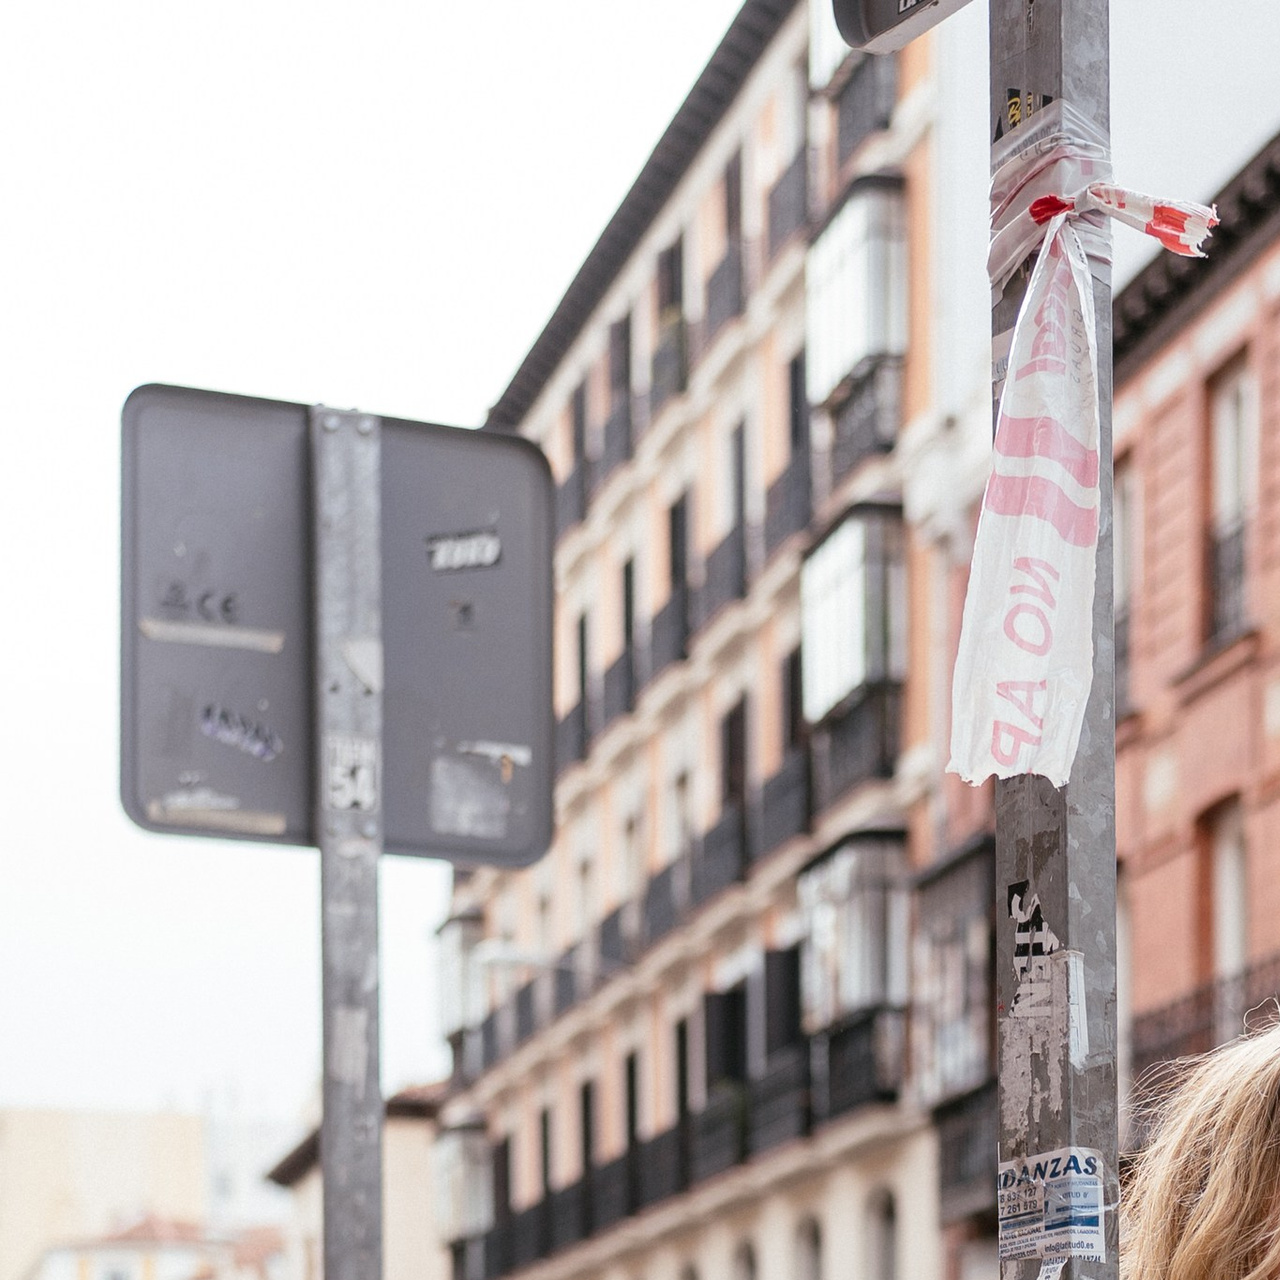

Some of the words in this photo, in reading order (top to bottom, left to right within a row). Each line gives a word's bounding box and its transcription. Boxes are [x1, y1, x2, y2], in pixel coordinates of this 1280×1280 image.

[1024, 1187, 1037, 1198] 127
[1007, 1203, 1021, 1214] 261
[1023, 1200, 1037, 1210] 579
